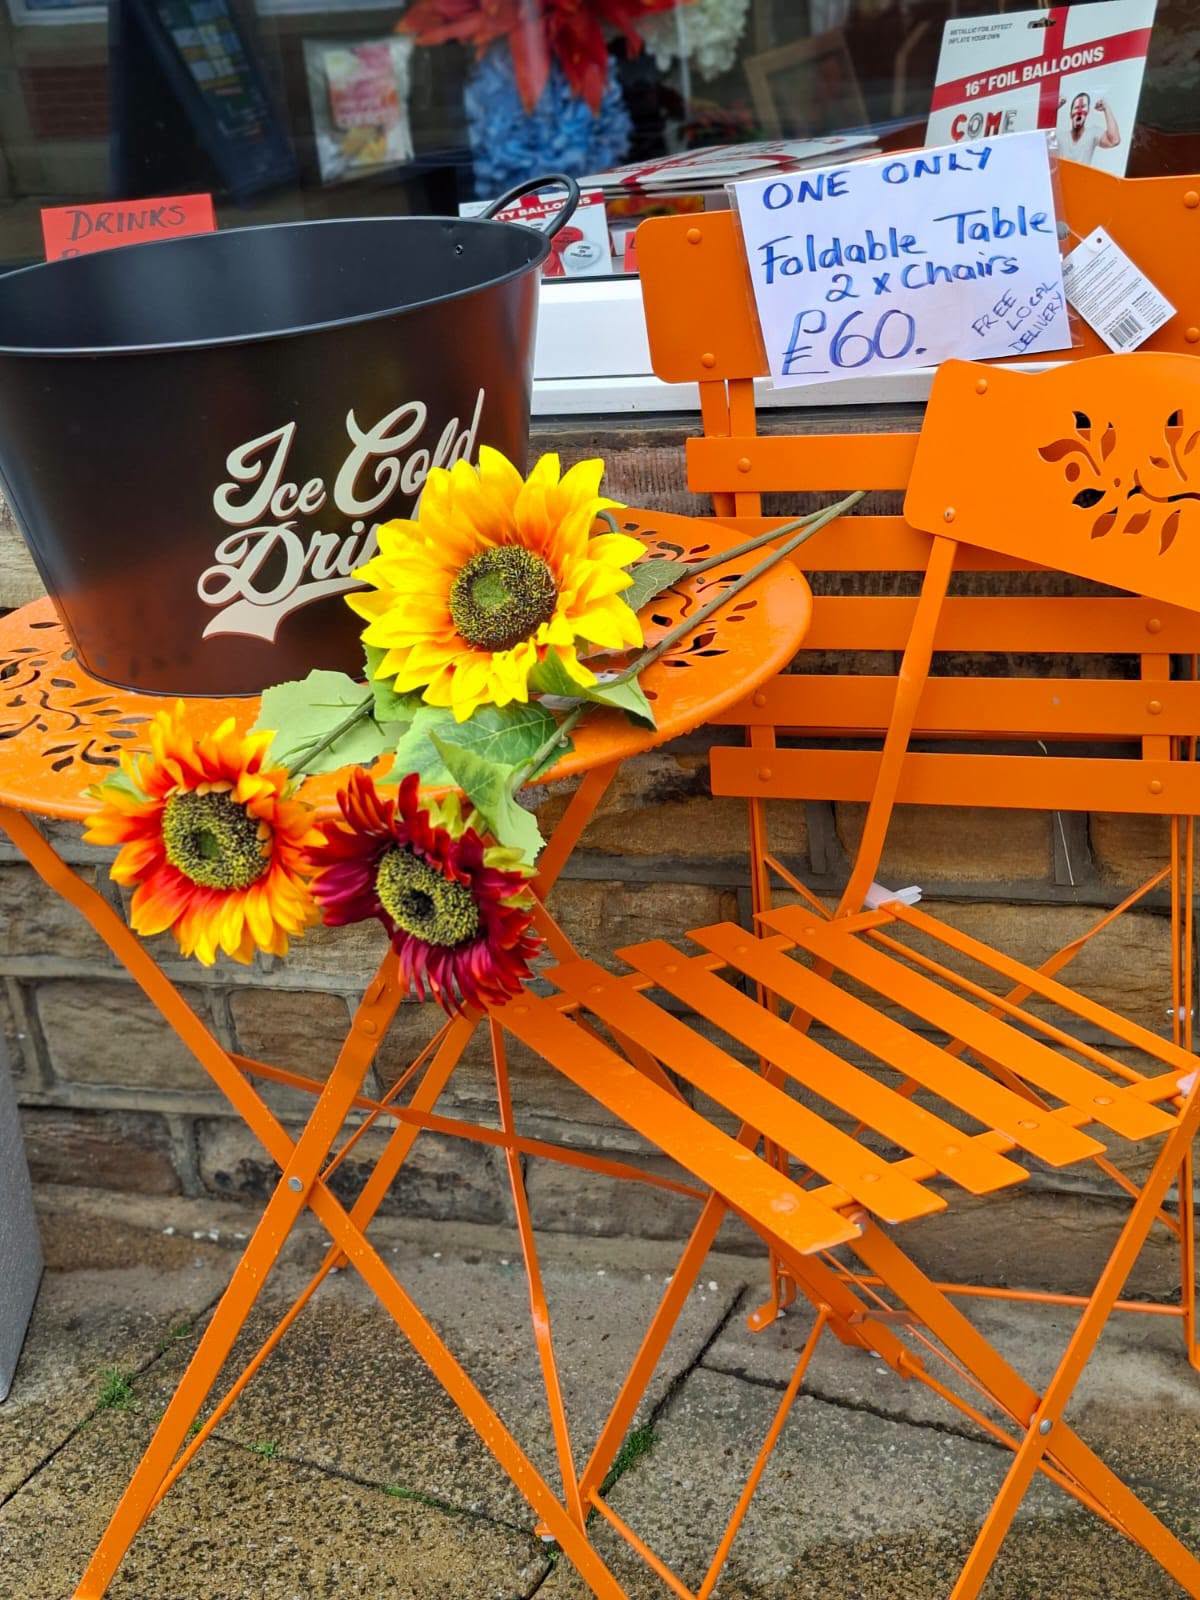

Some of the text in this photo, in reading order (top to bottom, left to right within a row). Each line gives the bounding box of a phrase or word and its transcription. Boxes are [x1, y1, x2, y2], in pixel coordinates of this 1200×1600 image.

[988, 71, 1019, 91] FOIL
[1022, 46, 1105, 80] BALLOONS
[950, 109, 1017, 140] COME
[763, 147, 992, 209] ONE ONLY
[64, 205, 186, 241] DRINKS
[518, 196, 592, 216] BALLOS
[757, 205, 1054, 284] Foldable Table
[825, 274, 860, 302] 2
[900, 251, 1019, 289] Chairs
[971, 288, 1017, 337] FREE
[1006, 281, 1058, 331] LOCAL
[1008, 291, 1063, 352] DELIVERY
[781, 309, 928, 375] £60.
[213, 421, 327, 525] Ice
[197, 520, 381, 607] Dri
